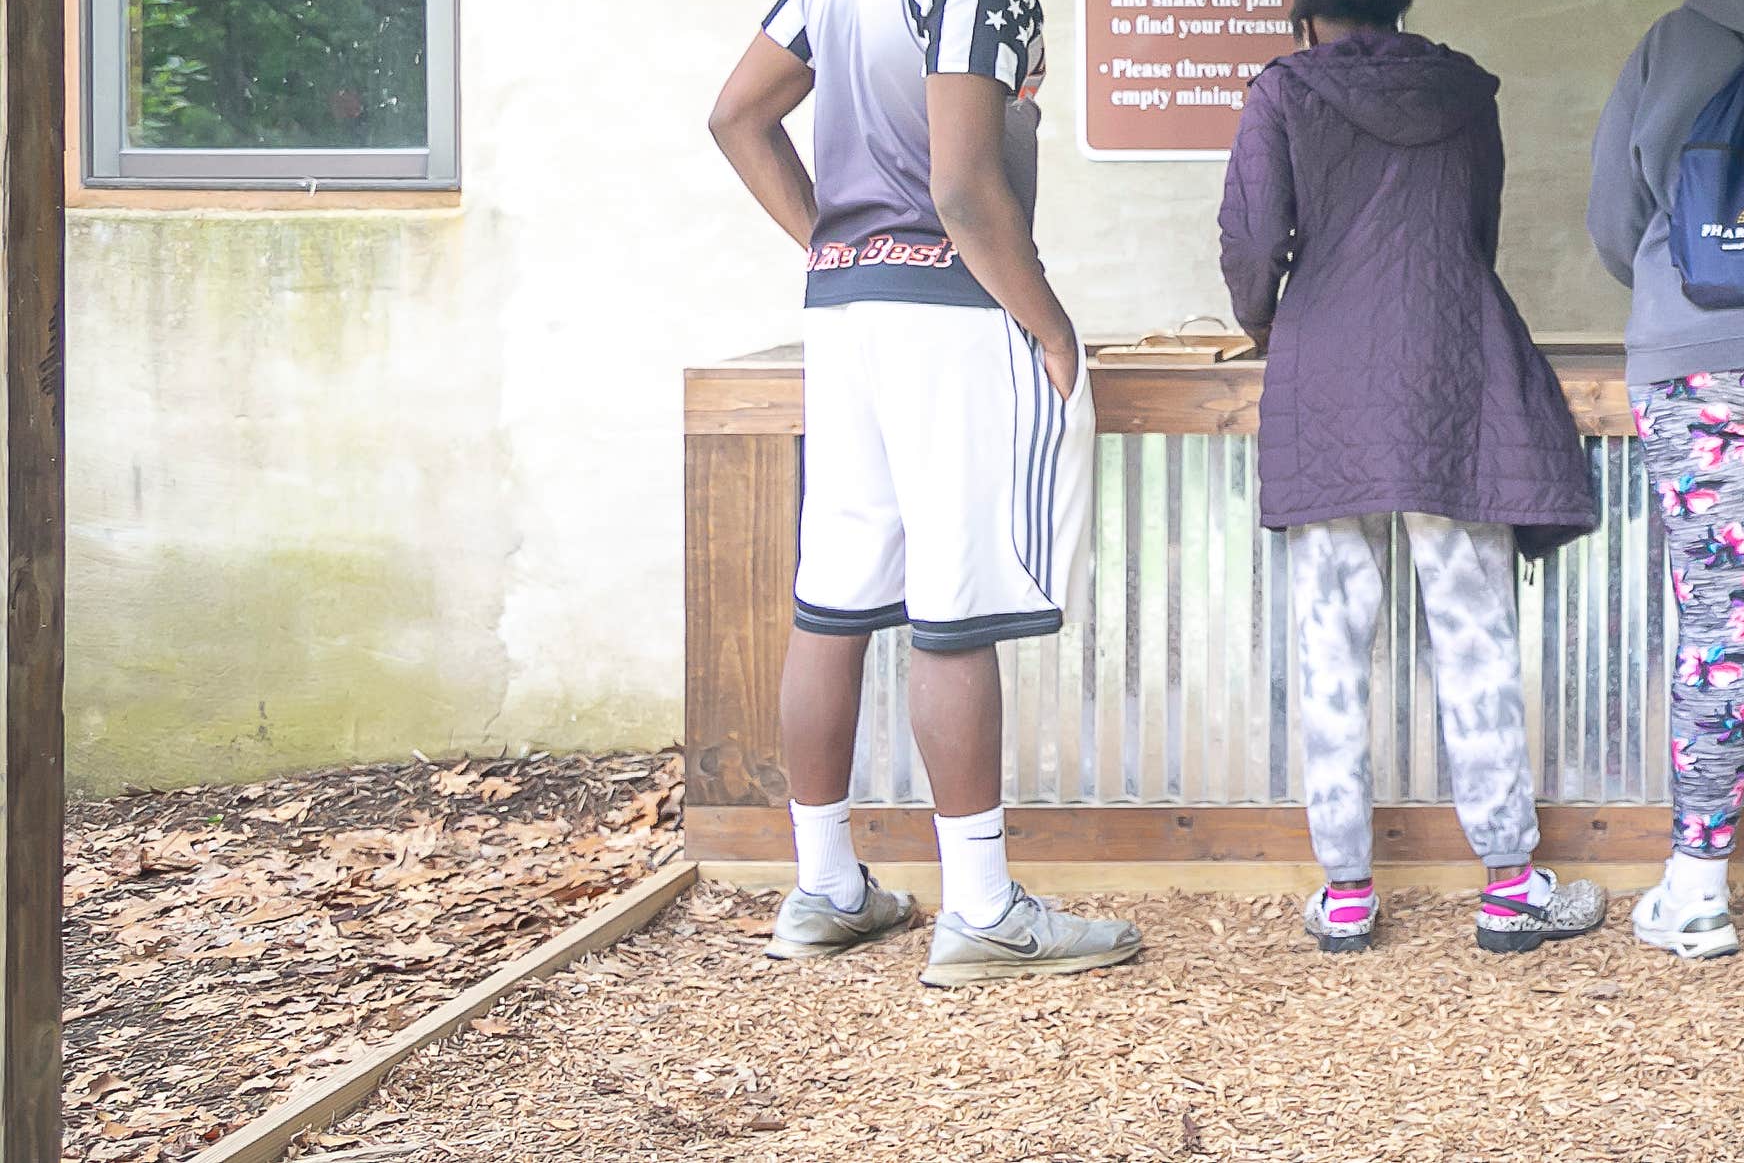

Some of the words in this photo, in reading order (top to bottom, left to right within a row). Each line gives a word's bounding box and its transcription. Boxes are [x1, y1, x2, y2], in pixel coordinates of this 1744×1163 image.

[1111, 16, 1132, 35] to
[1135, 13, 1175, 35] find
[1178, 19, 1225, 39] your
[1227, 17, 1294, 35] treasur
[1110, 57, 1173, 79] Please
[1175, 58, 1233, 79] throw
[1110, 87, 1172, 111] empty
[1175, 85, 1245, 111] mining
[859, 235, 958, 268] Best
